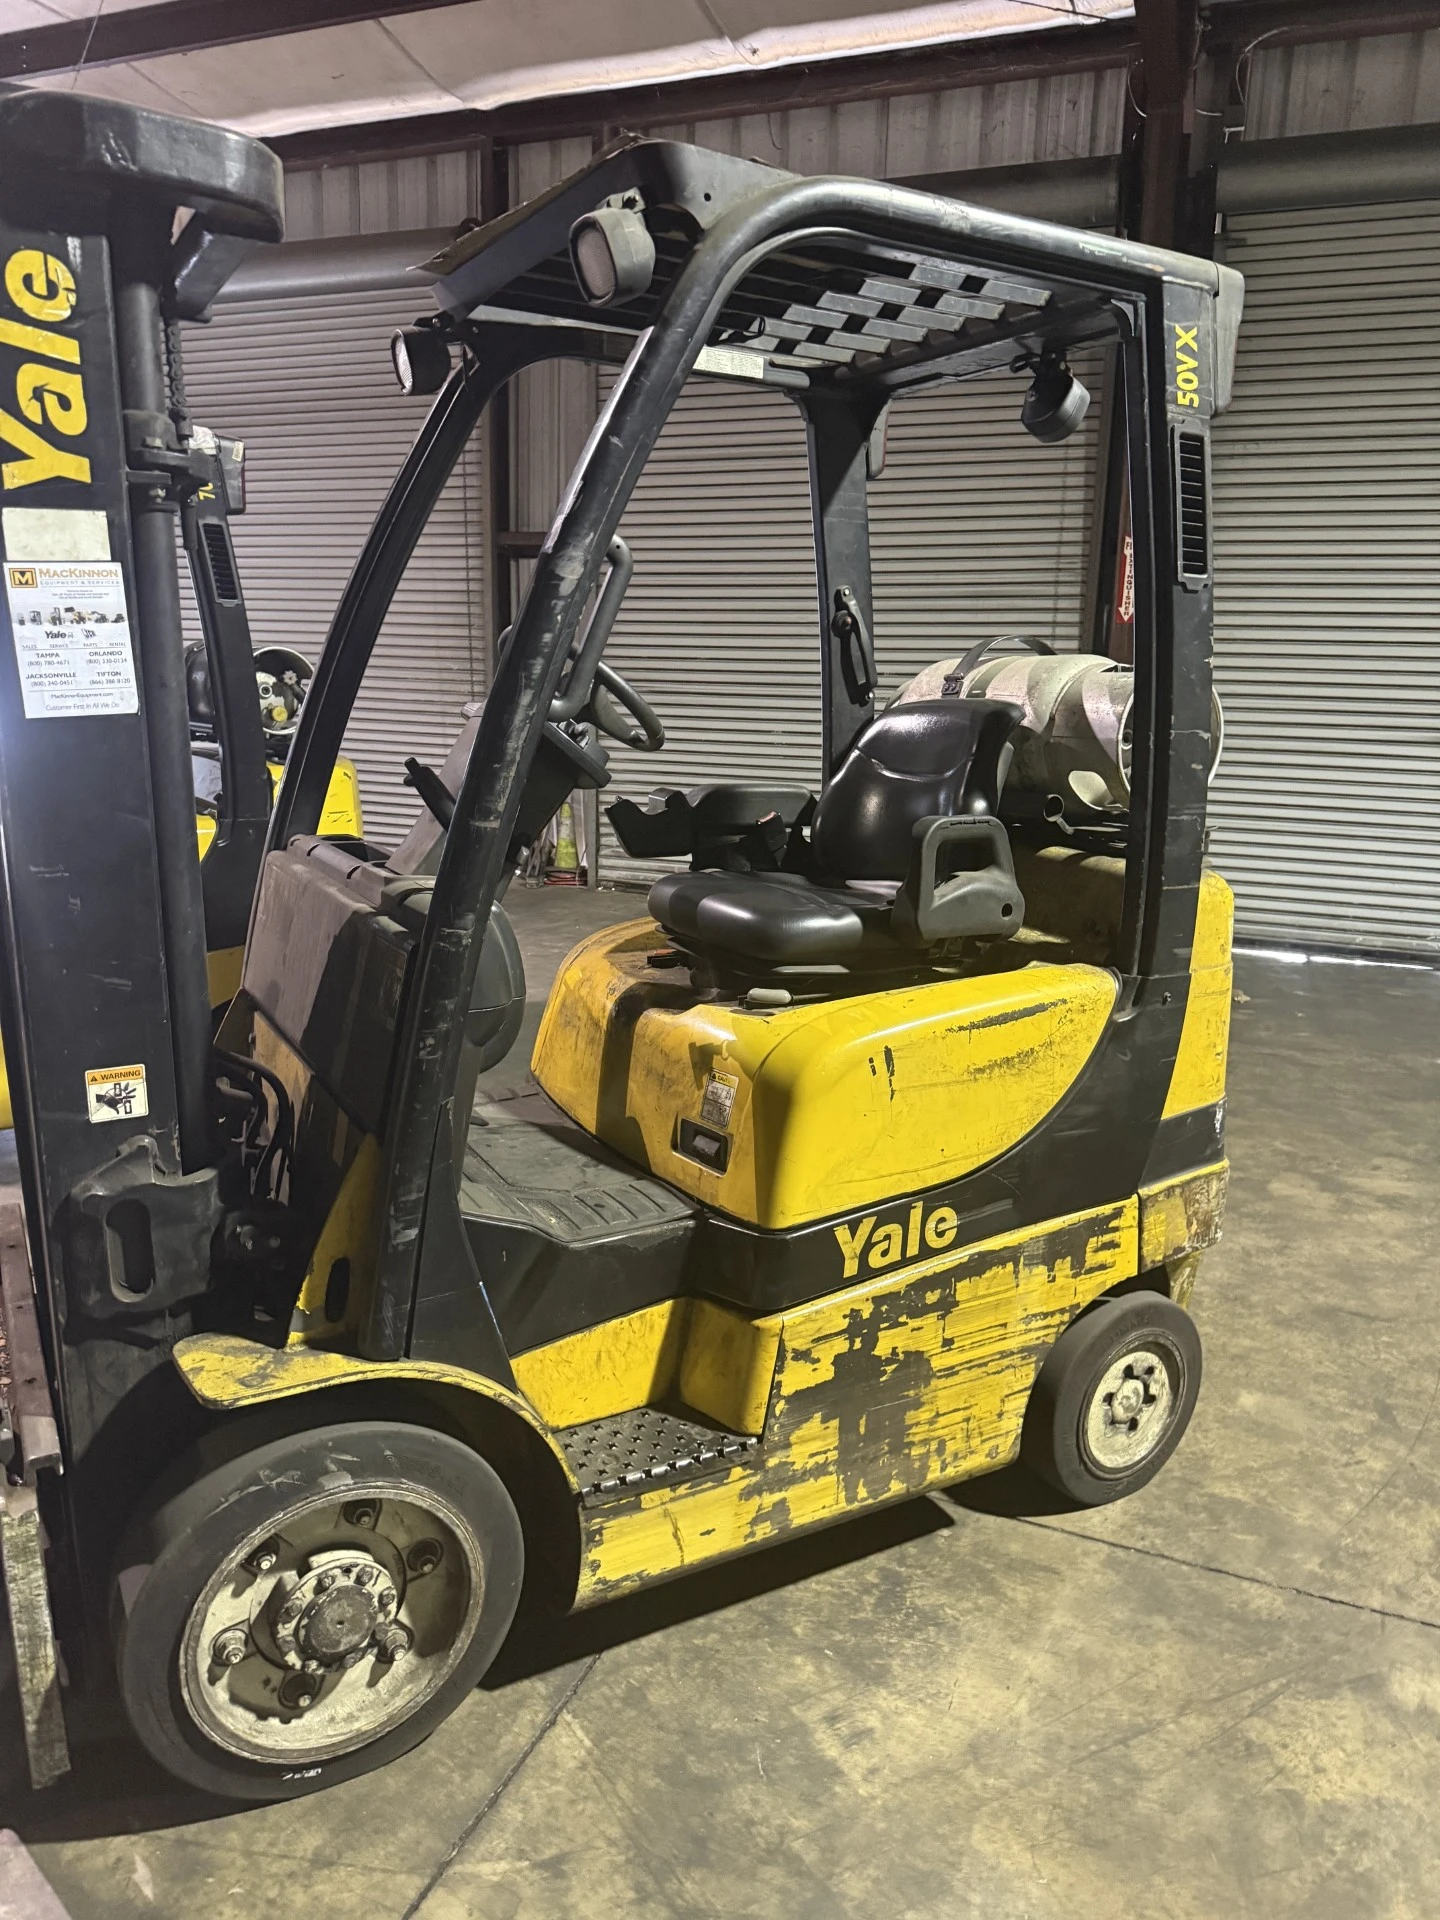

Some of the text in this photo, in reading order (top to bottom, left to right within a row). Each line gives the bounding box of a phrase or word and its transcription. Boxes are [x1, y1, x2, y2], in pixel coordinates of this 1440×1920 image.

[0, 249, 92, 490] Yale
[1174, 323, 1200, 409] 50VX
[44, 630, 67, 639] Yale
[45, 703, 72, 711] Customer
[100, 1069, 141, 1081] WARNING
[833, 1200, 958, 1279] Yale
